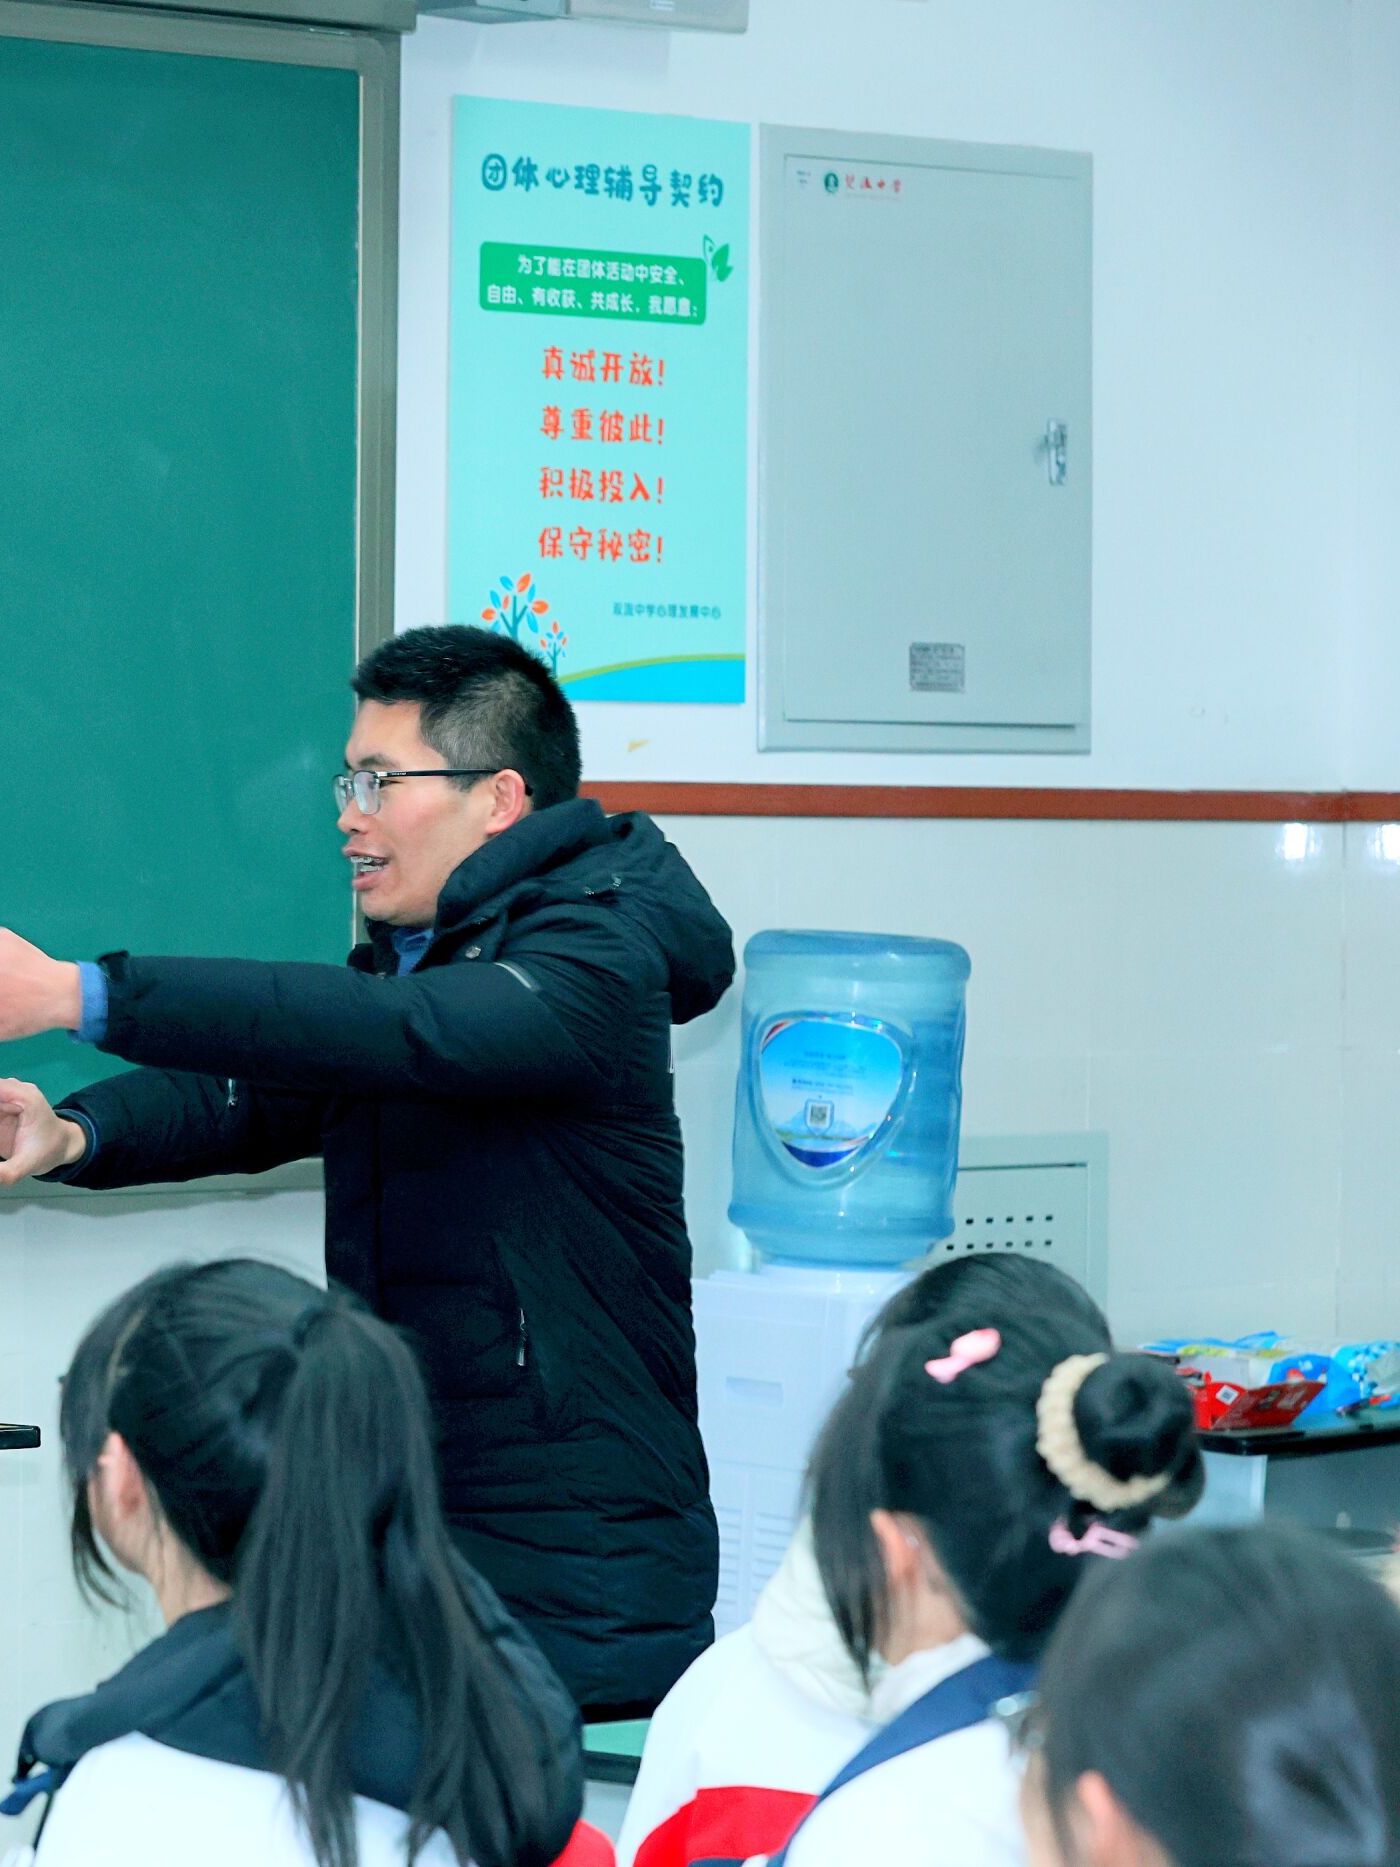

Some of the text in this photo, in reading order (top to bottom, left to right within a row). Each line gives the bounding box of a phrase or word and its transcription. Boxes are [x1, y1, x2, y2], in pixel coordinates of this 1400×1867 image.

[481, 153, 724, 207] 团体心理辅导契约
